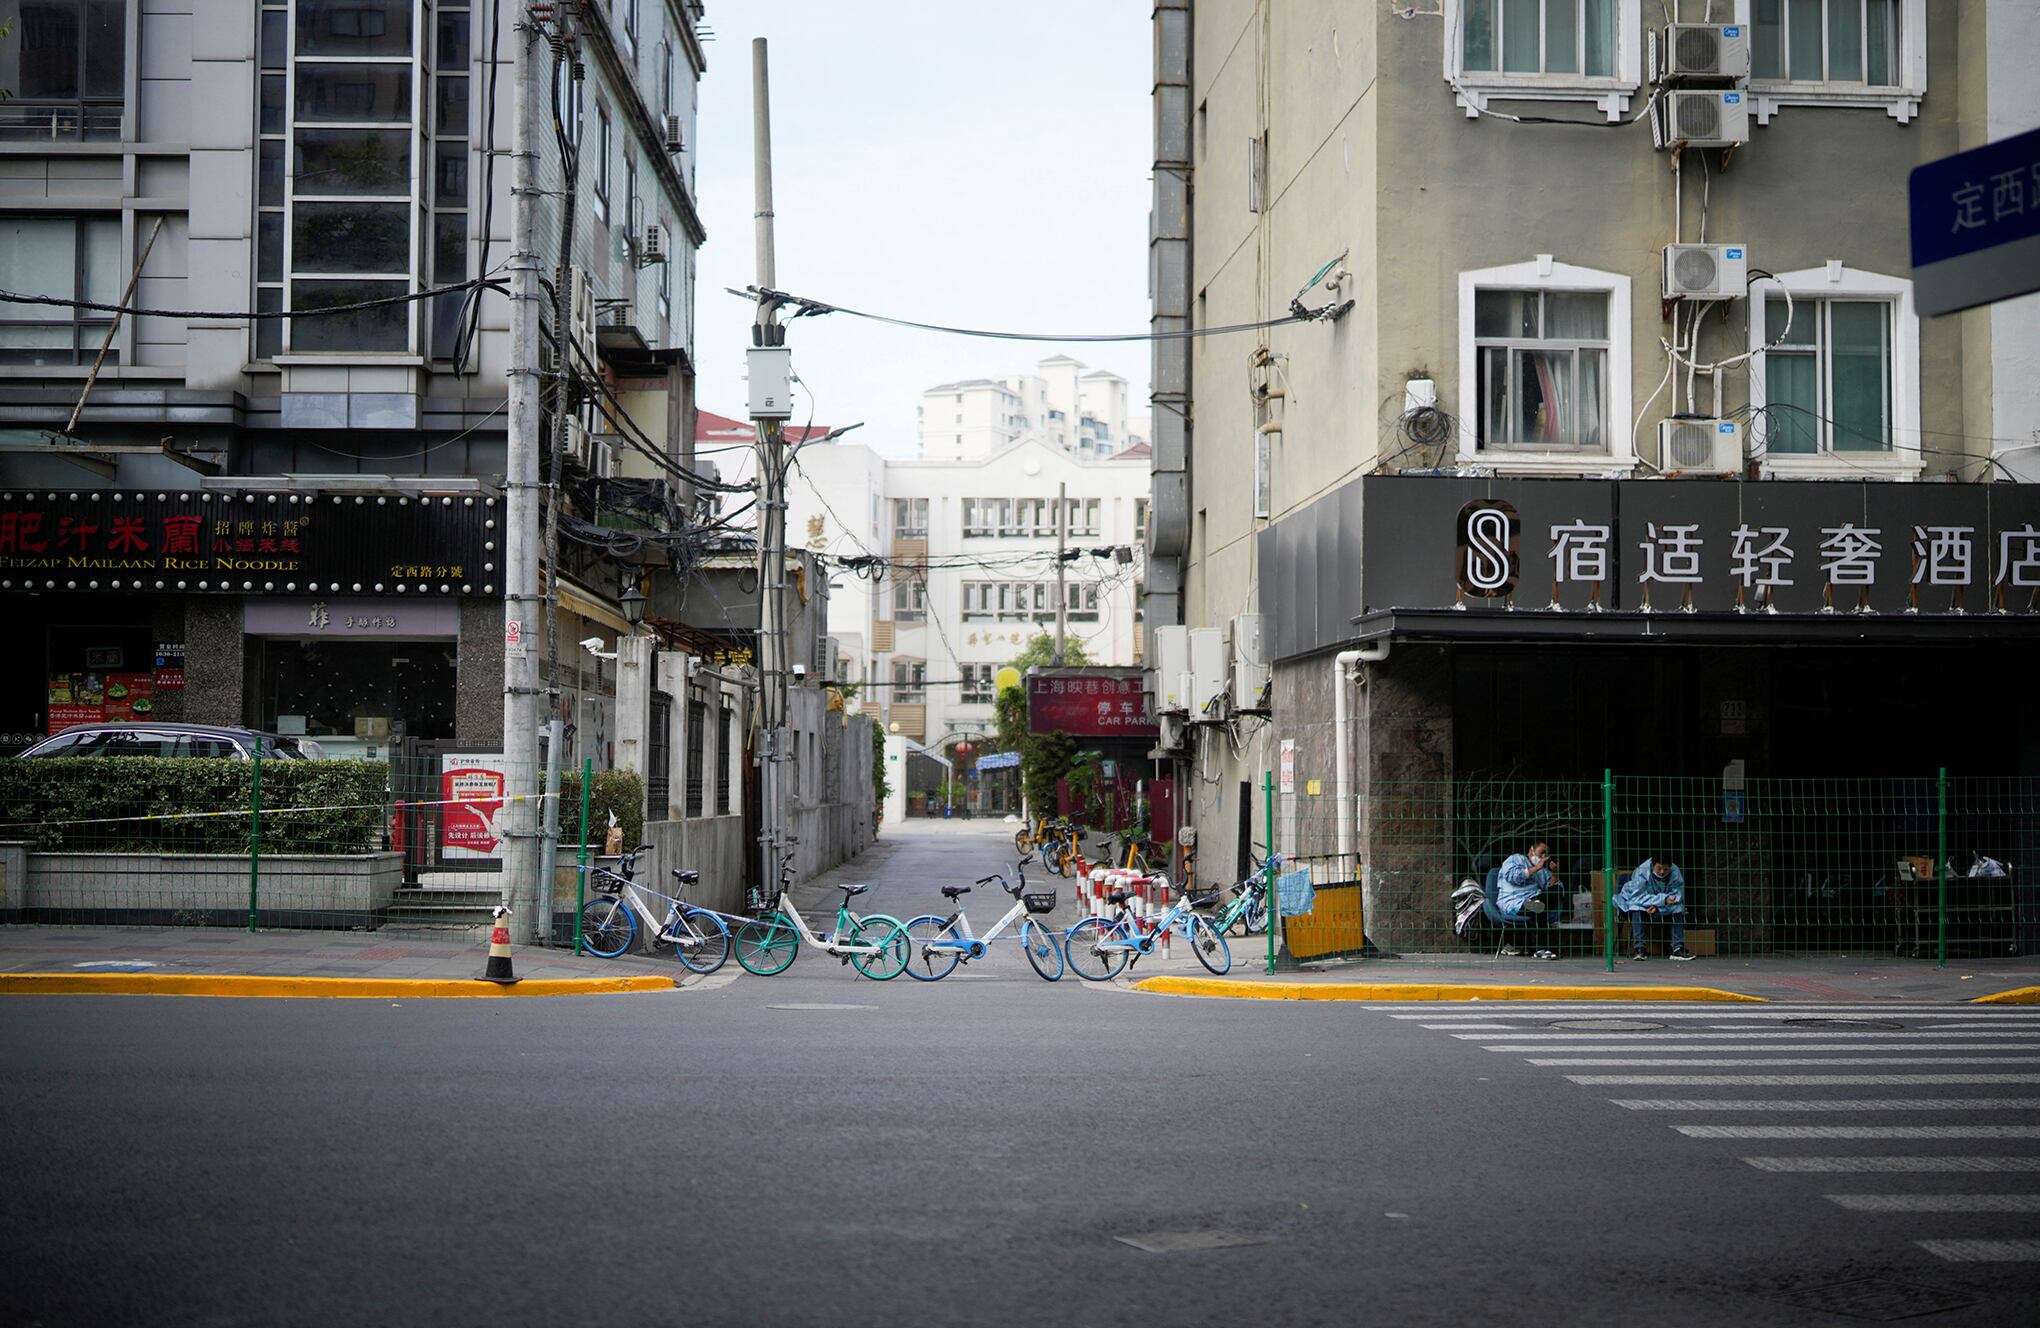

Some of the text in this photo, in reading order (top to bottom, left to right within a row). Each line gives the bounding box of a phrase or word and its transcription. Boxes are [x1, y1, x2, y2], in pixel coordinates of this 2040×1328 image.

[1951, 161, 2040, 234] 定西
[0, 512, 206, 554] 肥汁米蘭
[1548, 518, 2040, 587] 宿适轻奢酒店
[67, 555, 156, 569] MAILAAN
[165, 558, 209, 570] RICE
[216, 558, 299, 571] NOODLE
[391, 565, 464, 578] 定西路分號
[1097, 701, 1146, 715] 停车
[1097, 716, 1121, 725] CAR
